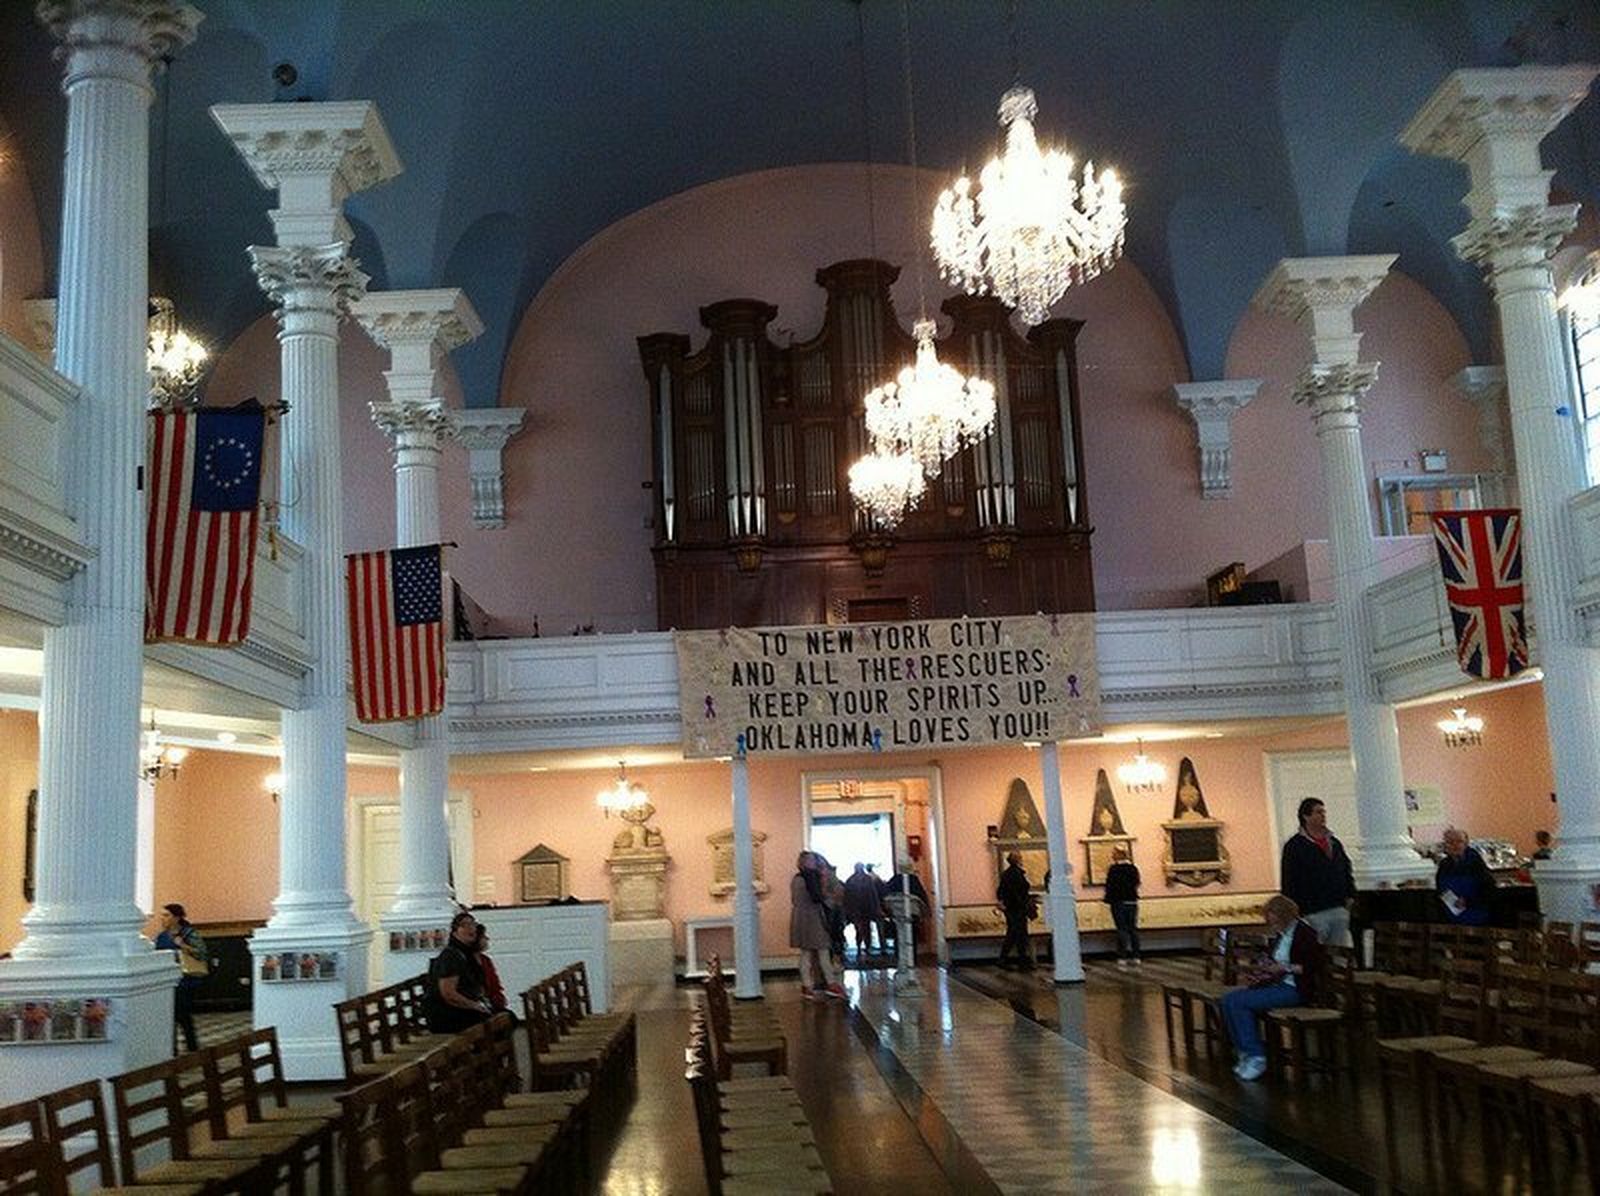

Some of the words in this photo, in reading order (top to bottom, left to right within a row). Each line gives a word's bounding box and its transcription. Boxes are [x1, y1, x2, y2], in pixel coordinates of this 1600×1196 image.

[757, 632, 788, 656] TO
[806, 629, 853, 655] NEW
[871, 624, 931, 651] YORK
[951, 620, 1002, 647] CITY
[732, 661, 775, 687] AND
[795, 660, 838, 685] ALL
[858, 656, 902, 683] THE
[921, 649, 1052, 679] RESCUERS:
[749, 692, 809, 718] KEEP
[829, 689, 889, 716] YOUR
[907, 683, 1001, 712] SPIRITS
[745, 721, 873, 751] OKLAHOMA
[893, 716, 970, 745] LOVES
[989, 711, 1049, 740] YOU!!
